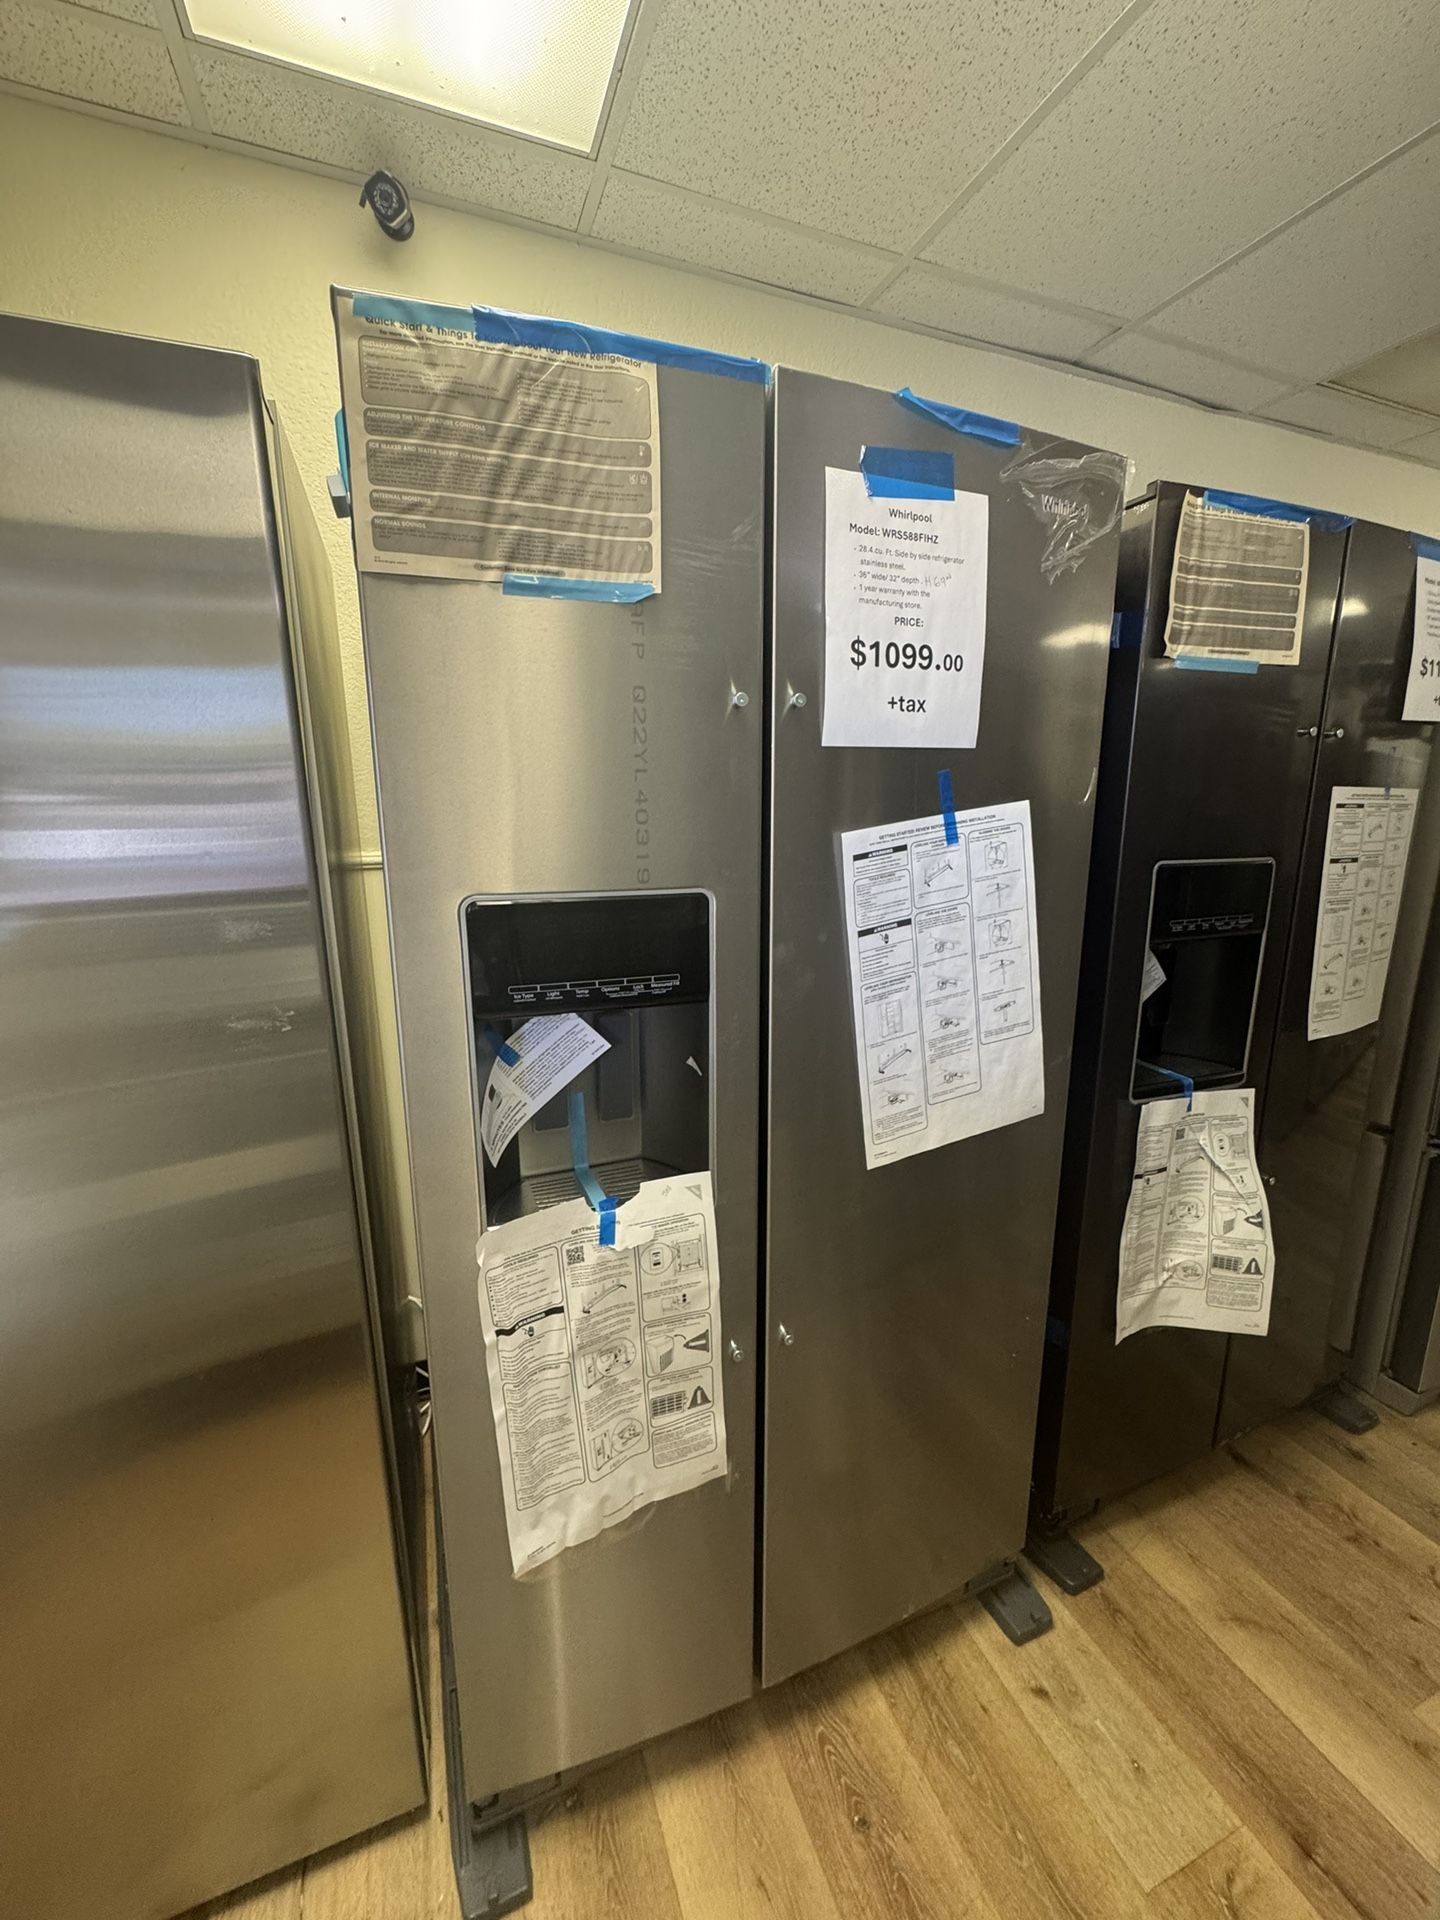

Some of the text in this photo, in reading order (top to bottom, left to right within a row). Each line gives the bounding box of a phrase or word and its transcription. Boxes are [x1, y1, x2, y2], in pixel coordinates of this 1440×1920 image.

[436, 326, 468, 341] Things
[589, 352, 642, 369] Refrigerator
[888, 508, 933, 523] Whirlpool
[849, 523, 880, 537] Model:
[860, 558, 888, 569] stainless
[894, 549, 909, 558] Side
[909, 551, 917, 560] by
[918, 553, 931, 561] side
[932, 554, 965, 565] refrigerator
[901, 575, 920, 585] depth
[864, 585, 877, 594] year
[879, 586, 905, 598] warranty
[906, 589, 920, 597] with
[920, 590, 931, 598] the
[858, 597, 904, 610] manufacturing
[894, 616, 924, 628] PRICE:
[850, 635, 964, 673] $1099.00
[887, 696, 927, 713] +tax
[570, 1224, 595, 1236] GETTING
